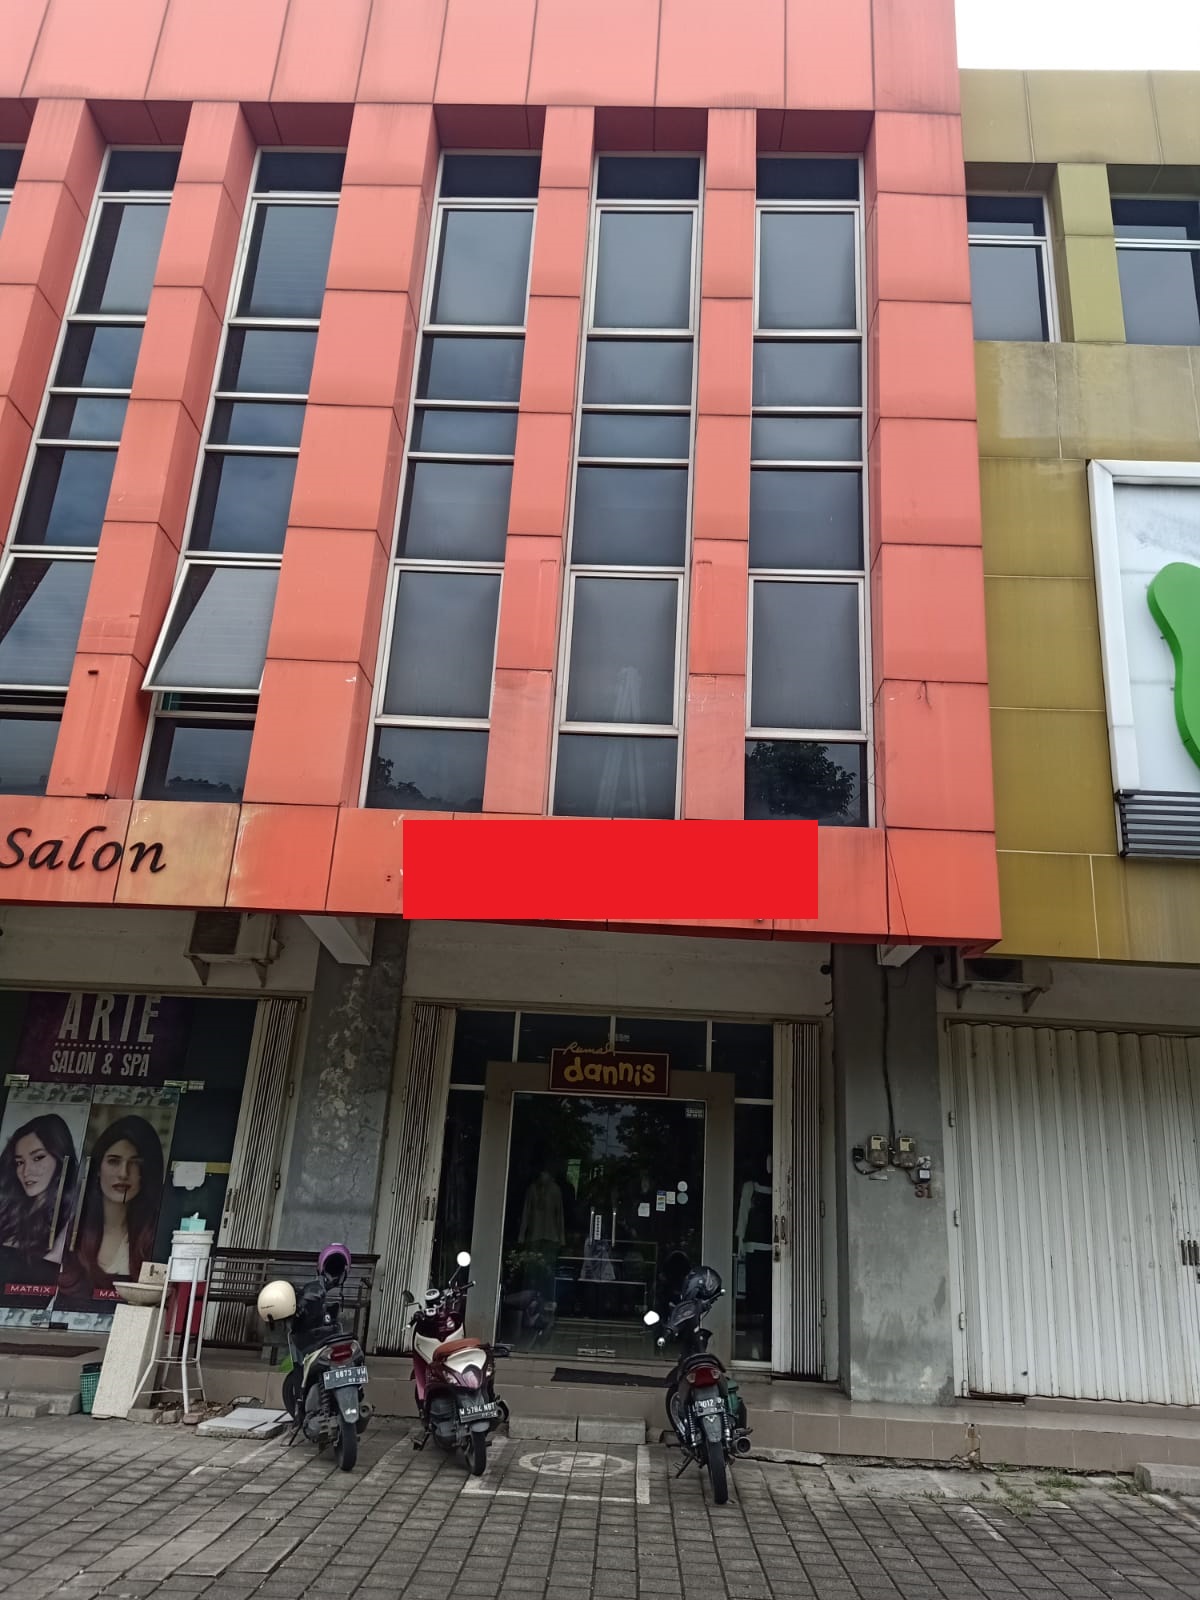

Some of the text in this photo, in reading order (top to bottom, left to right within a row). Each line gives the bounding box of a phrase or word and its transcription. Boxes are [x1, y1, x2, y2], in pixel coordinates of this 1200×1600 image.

[0, 826, 167, 873] Salon
[57, 993, 161, 1042] ARIE
[50, 1050, 151, 1077] SALON & SPA
[563, 1056, 656, 1087] dannis
[10, 1285, 50, 1293] MATRIX
